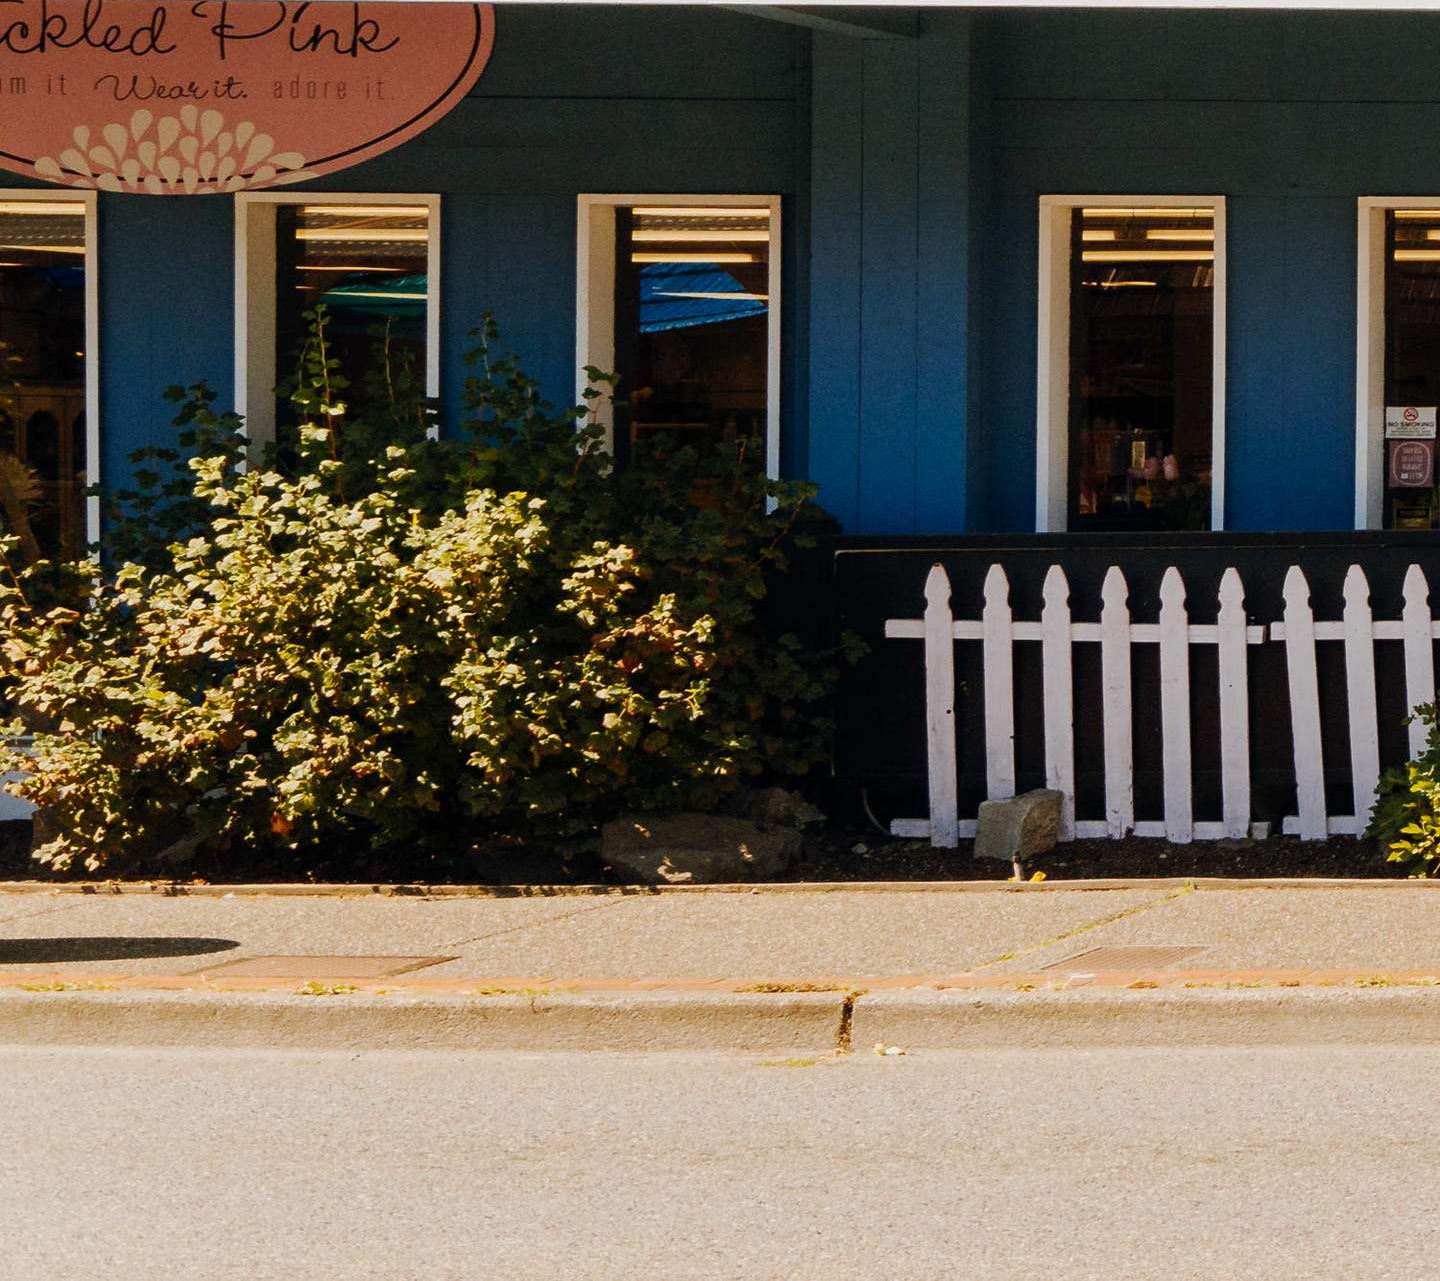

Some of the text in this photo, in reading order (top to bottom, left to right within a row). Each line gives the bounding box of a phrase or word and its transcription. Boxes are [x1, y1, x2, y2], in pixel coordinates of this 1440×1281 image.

[191, 1, 400, 60] Pink
[94, 74, 207, 101] Wear
[272, 77, 347, 99] adore
